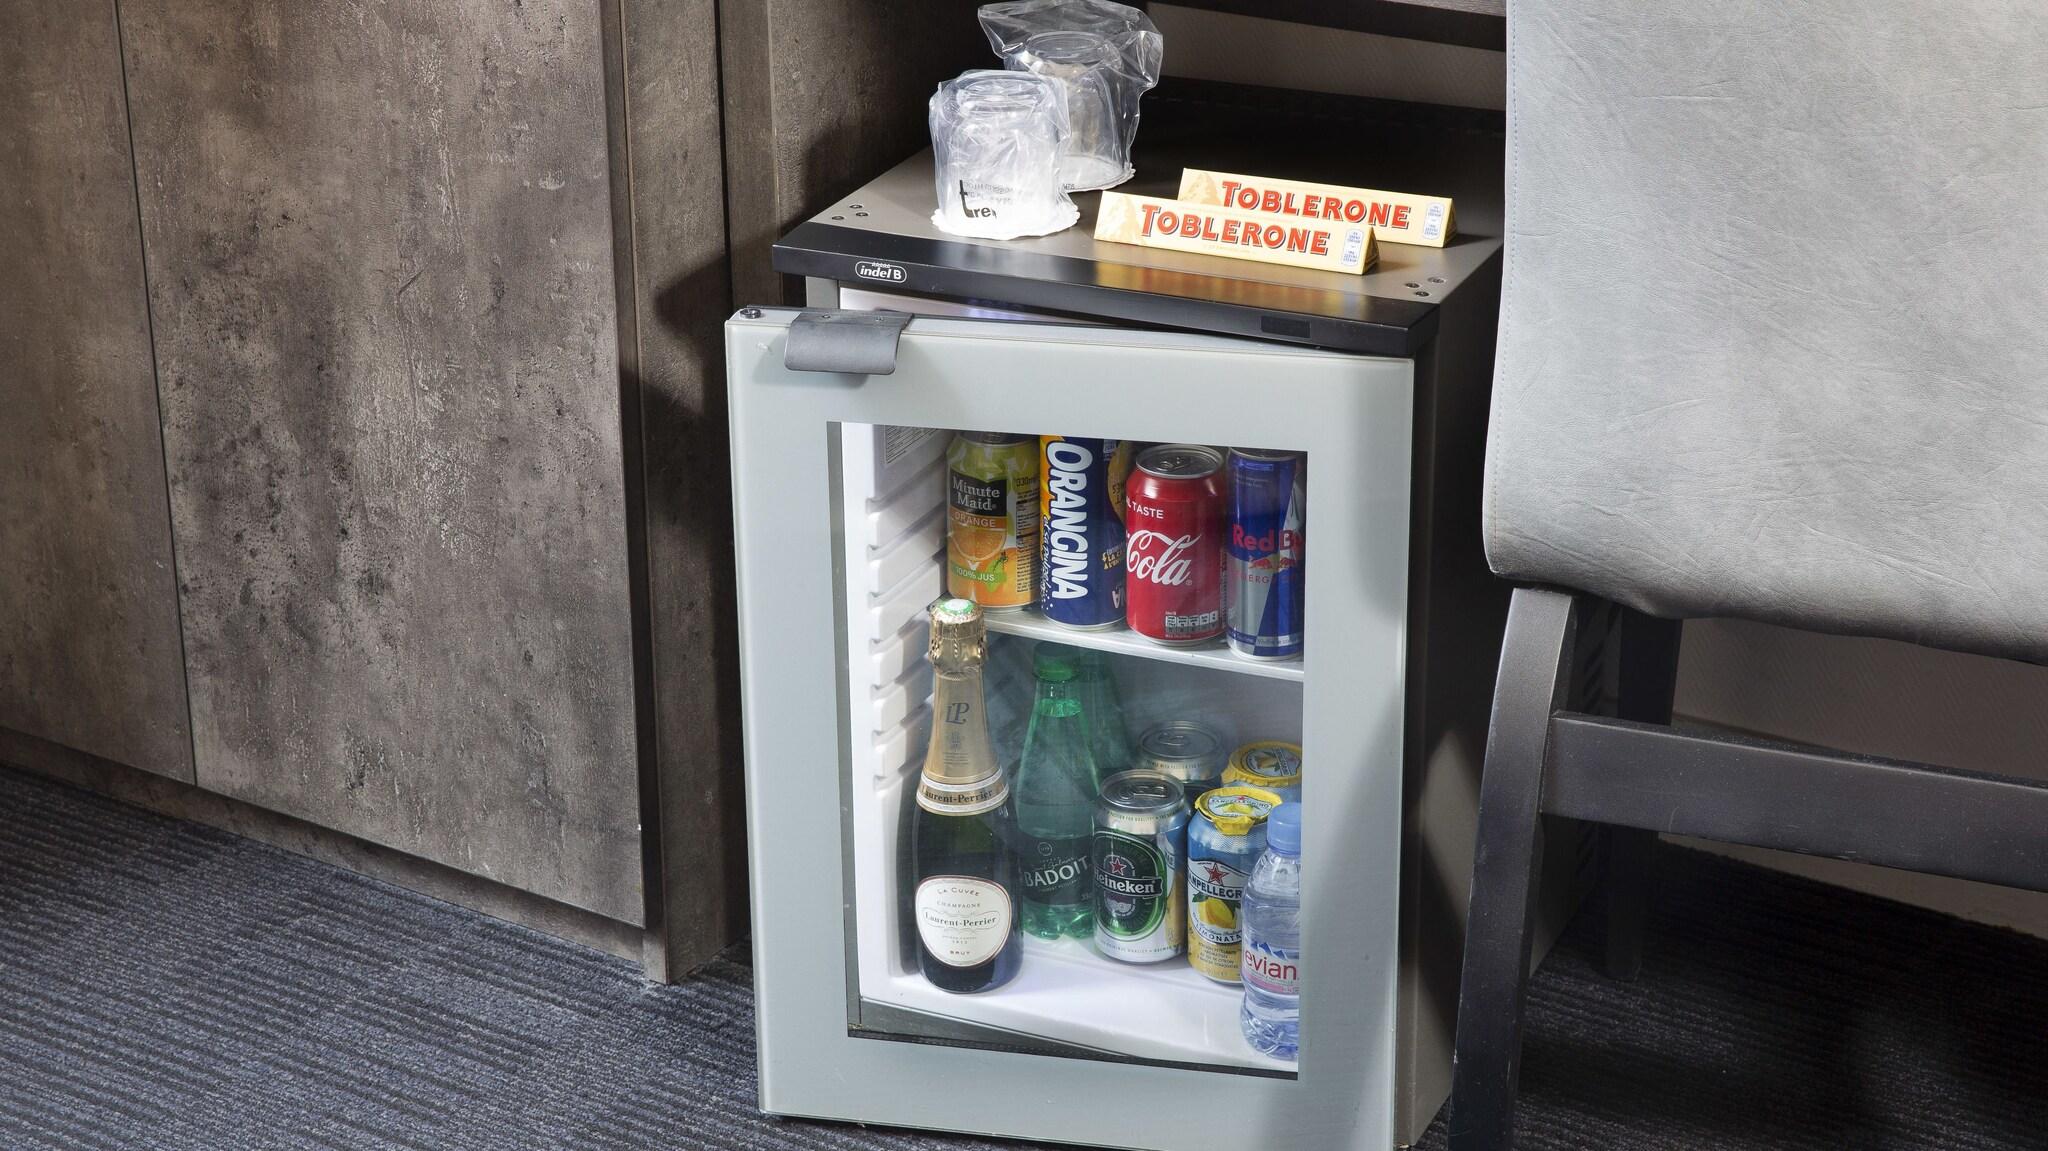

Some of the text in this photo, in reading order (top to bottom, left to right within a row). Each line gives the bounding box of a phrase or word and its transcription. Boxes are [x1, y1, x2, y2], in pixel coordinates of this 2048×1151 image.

[1222, 180, 1411, 230] TOBLERONE
[1141, 203, 1329, 256] TOBLERONE
[860, 265, 902, 280] indel B
[952, 476, 1001, 498] Minute
[957, 491, 994, 511] Maid
[1131, 500, 1165, 520] TASTE
[953, 511, 997, 528] ORANGE
[1047, 441, 1094, 599] ORANGINA
[1231, 522, 1276, 552] Red
[1126, 529, 1202, 586] Cola
[955, 565, 996, 582] 100% JUS
[921, 784, 993, 804] Laurent-Perrier
[1023, 855, 1088, 887] BADOIT
[936, 900, 981, 908] CHAMPAGNE
[925, 911, 997, 926] Laurent-Perrier
[1245, 950, 1297, 981] evian
